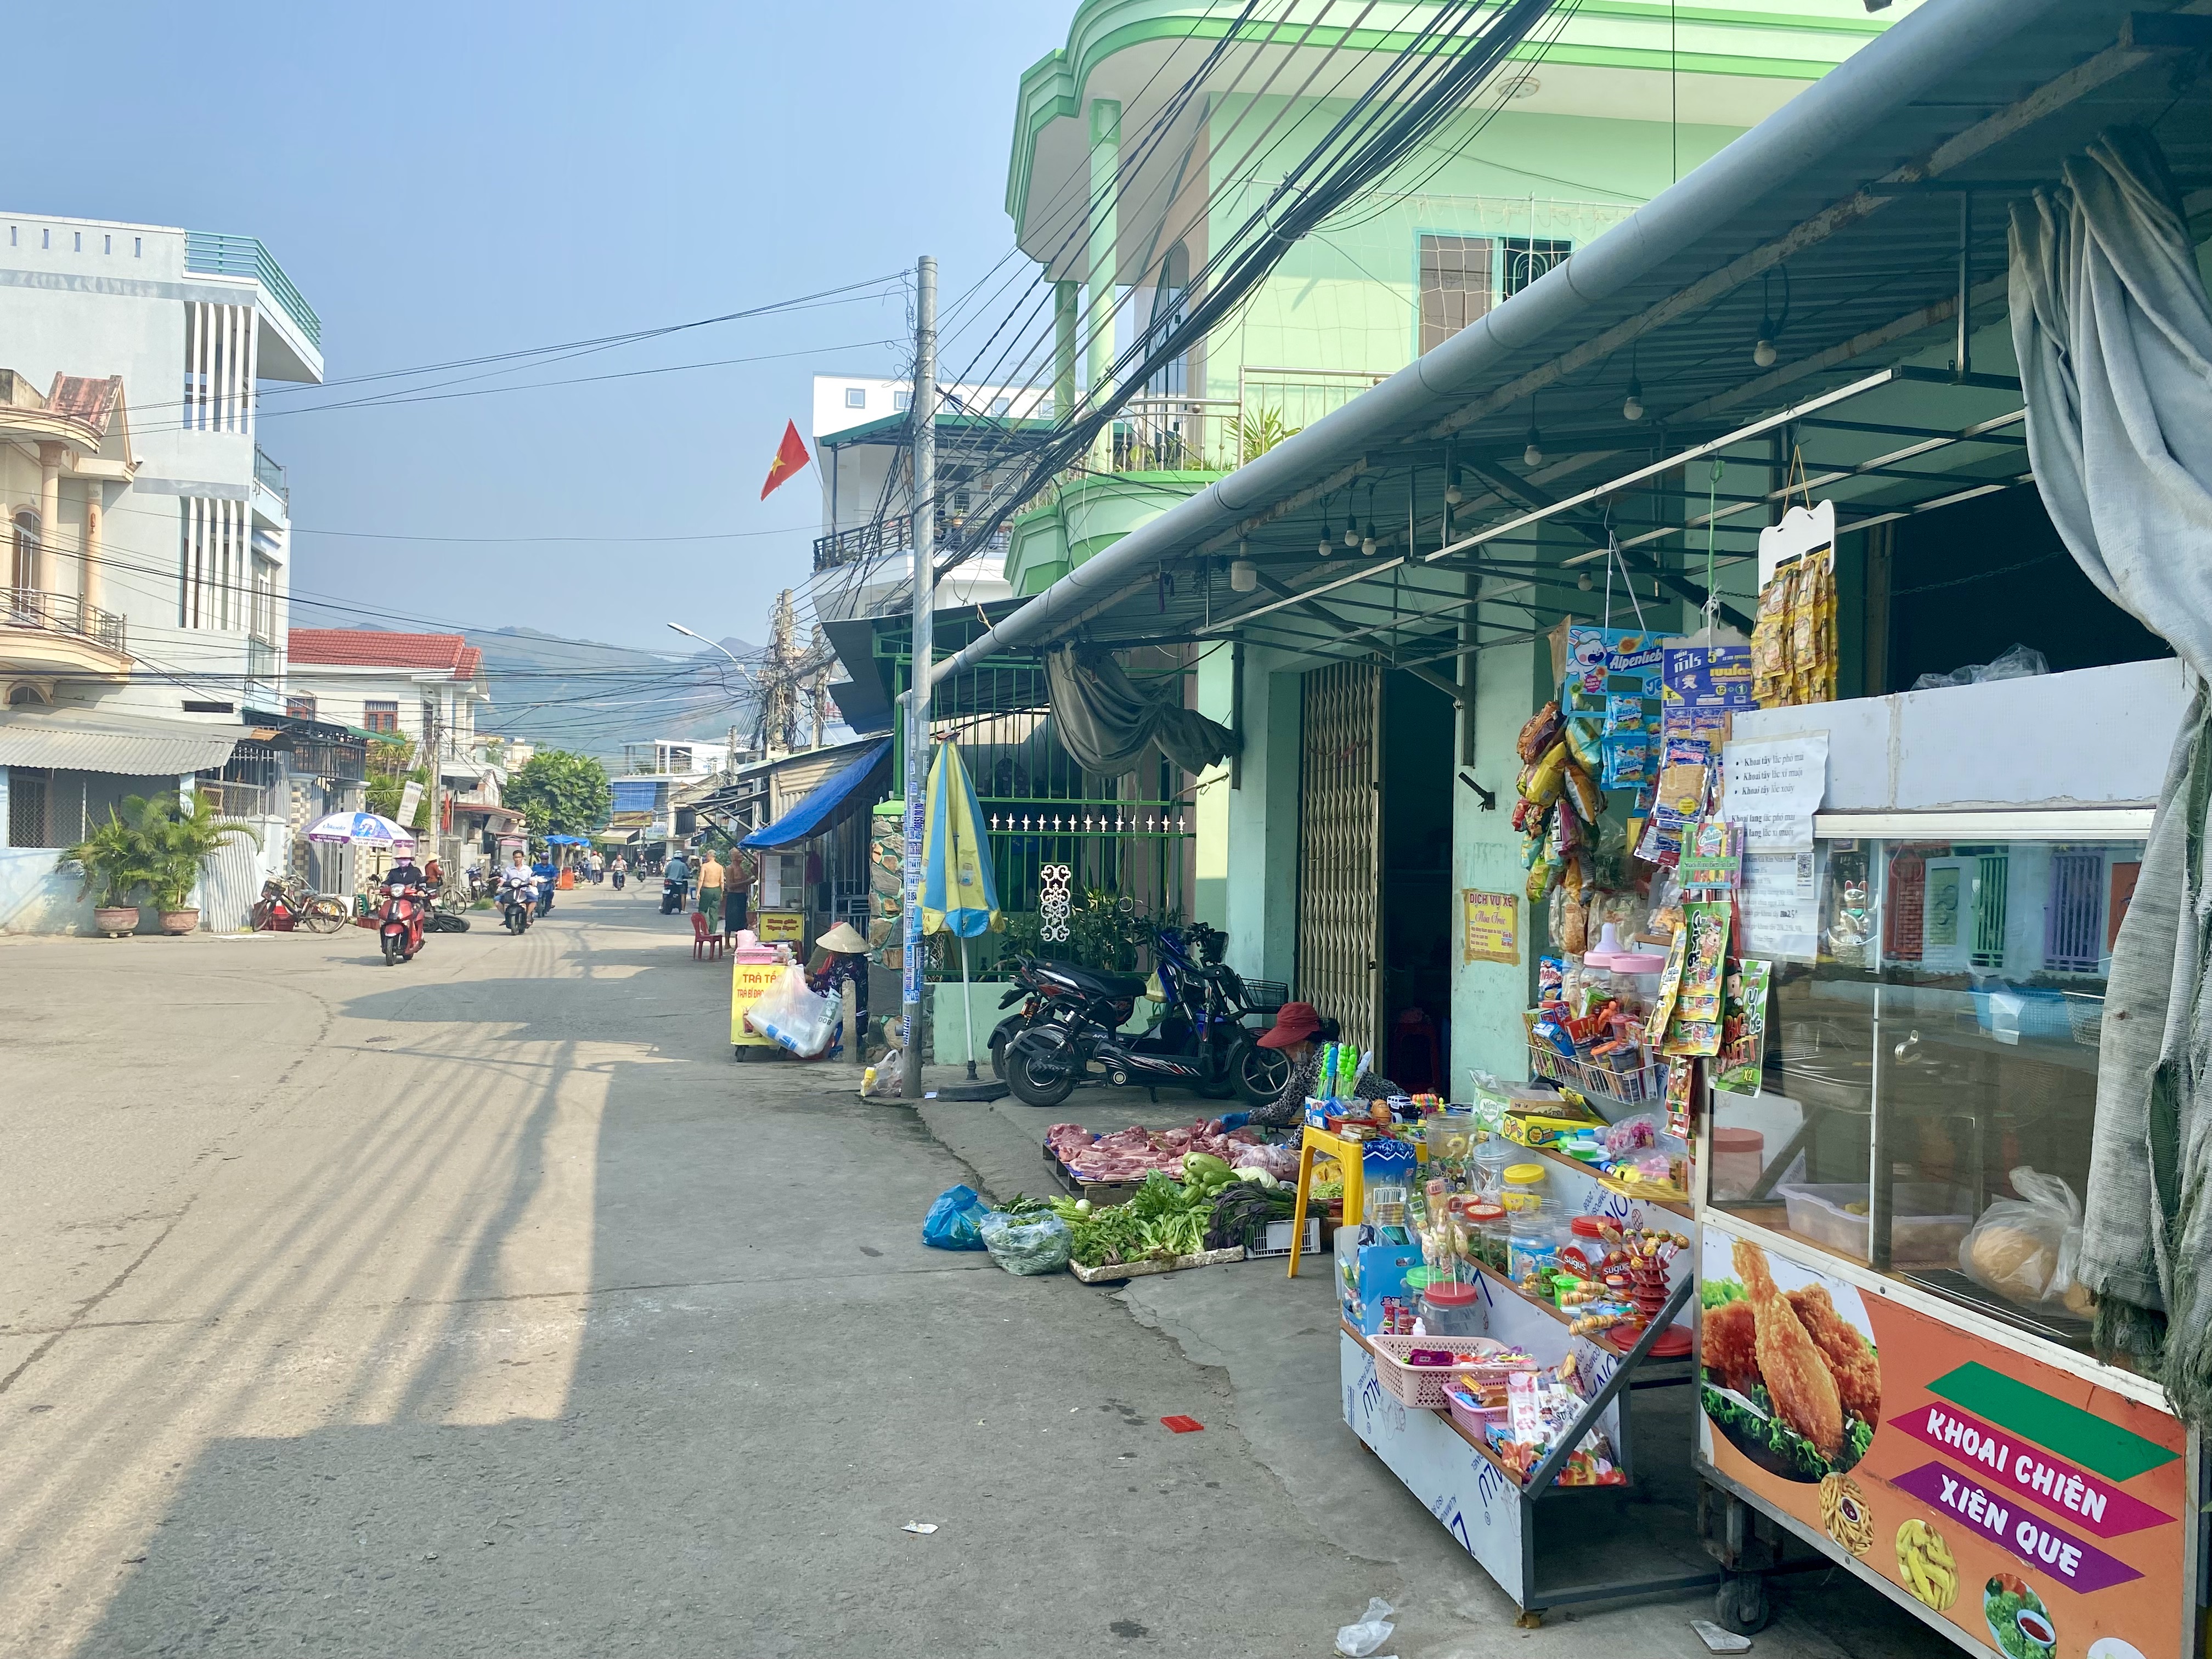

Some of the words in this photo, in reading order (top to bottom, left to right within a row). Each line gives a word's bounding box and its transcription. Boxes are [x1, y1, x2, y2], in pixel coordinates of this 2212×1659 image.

[1610, 648, 1662, 672] Alpenlieb
[1744, 757, 1760, 766] Khoai
[1762, 756, 1771, 766] tây
[1743, 771, 1760, 781] Khoai
[1762, 770, 1770, 781] tây
[1742, 786, 1760, 795] Khoai
[1761, 785, 1770, 795] tây
[1750, 815, 1762, 824] lang
[1750, 829, 1761, 839] lang
[1503, 896, 1513, 906] XE
[743, 972, 761, 983] TRÀ
[737, 988, 747, 998] TRÀ
[748, 987, 753, 998] BÍ
[1565, 1255, 1586, 1271] sugus
[1926, 1408, 2010, 1473] KHOAI
[2015, 1454, 2107, 1523] CHIÊN
[1939, 1473, 2007, 1537] XIÊN
[2016, 1520, 2083, 1578] QUE
